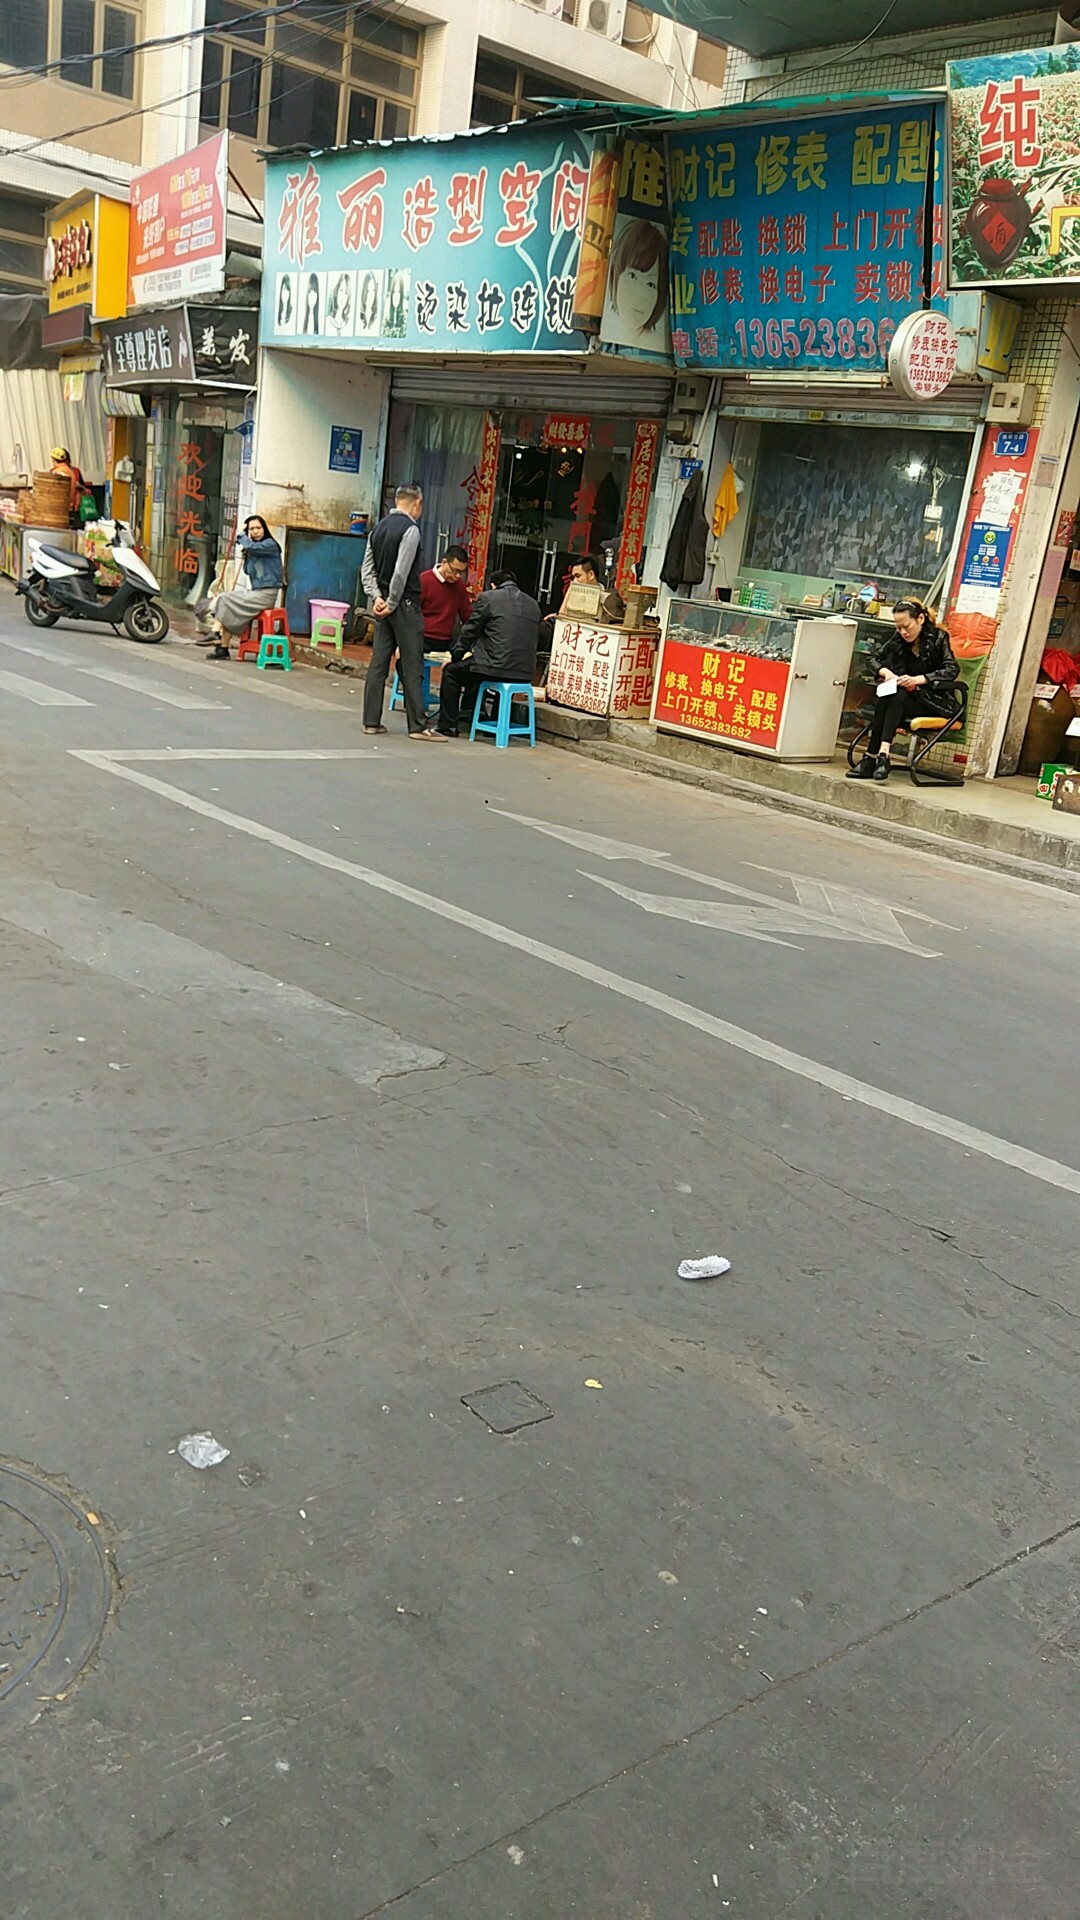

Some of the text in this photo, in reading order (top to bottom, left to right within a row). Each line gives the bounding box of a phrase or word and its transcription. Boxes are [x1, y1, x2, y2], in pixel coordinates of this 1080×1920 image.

[978, 76, 1043, 169] 纯
[671, 120, 940, 203] 财记 修表 配匙
[277, 160, 593, 269] 雅丽造型空间
[697, 203, 944, 258] 配匙 换锁 上门开锁
[700, 259, 948, 306] 修表 换电子 卖锁头
[415, 276, 578, 335] 烫染拉连锁
[672, 328, 719, 359] 电话
[924, 320, 948, 336] 财记
[113, 324, 173, 373] 至尊理发店
[908, 353, 956, 371] 配匙 开锁
[1003, 440, 1019, 453] 7-4
[174, 441, 207, 575] 欢迎光临
[559, 623, 610, 657] 财记
[551, 649, 610, 680] 上门开锁 配匙
[613, 633, 637, 712] 上门开锁
[701, 652, 746, 684] 财记
[583, 678, 608, 699] 换电子
[680, 713, 752, 740] 13652383682
